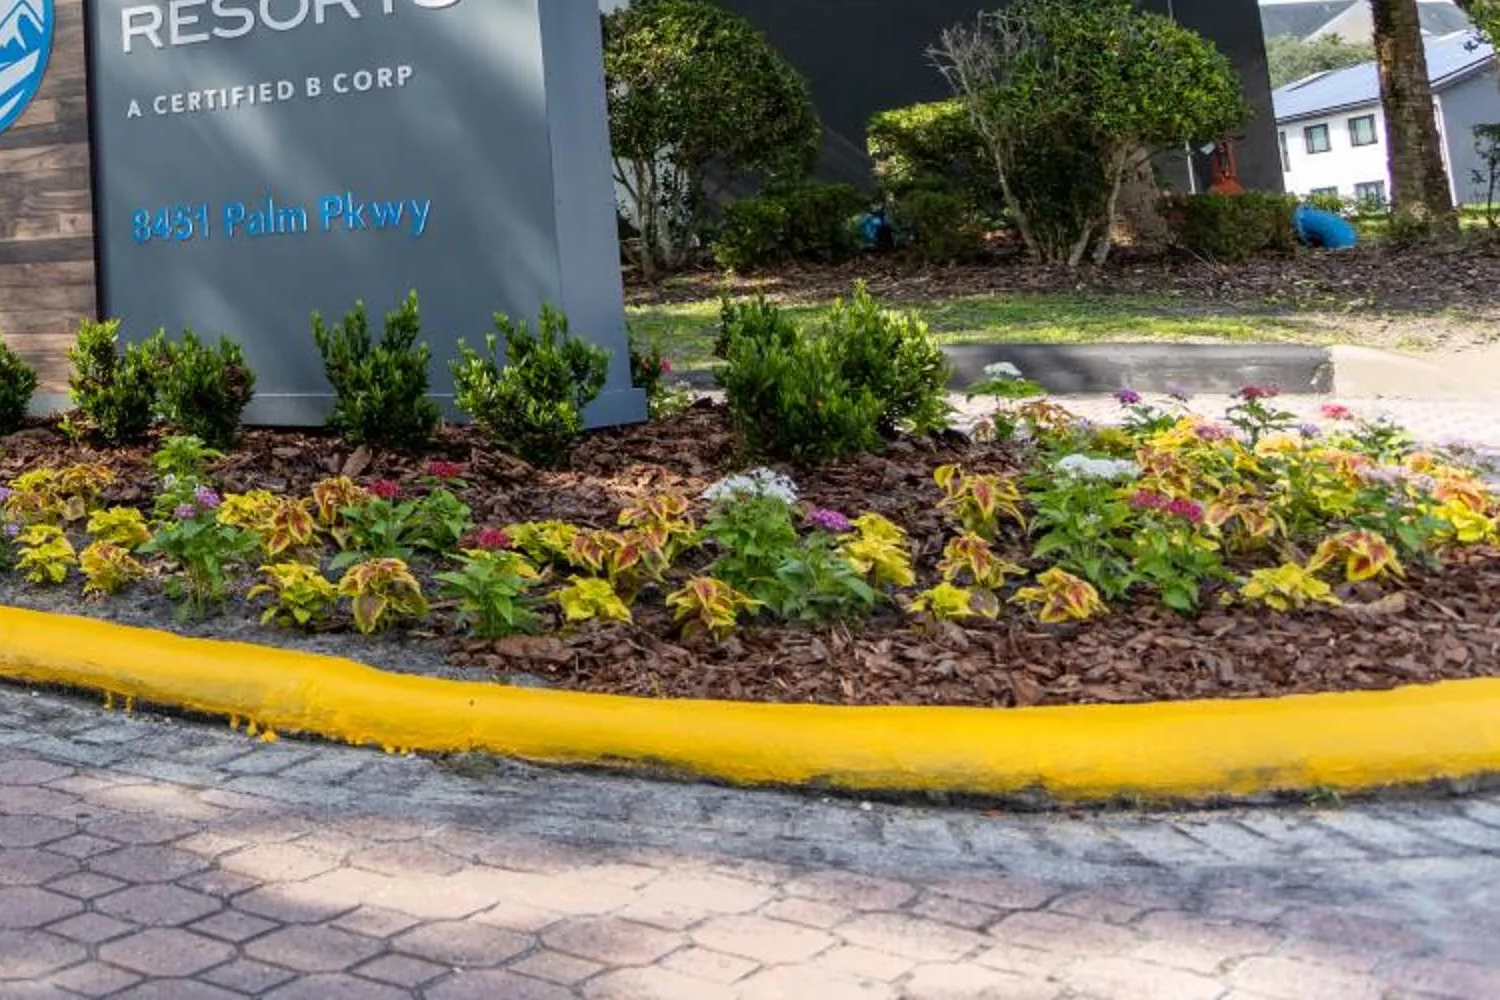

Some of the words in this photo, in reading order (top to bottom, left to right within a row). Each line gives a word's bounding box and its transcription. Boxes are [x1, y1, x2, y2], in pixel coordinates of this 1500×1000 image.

[127, 99, 143, 118] A
[153, 80, 295, 115] CERTIFIED
[306, 76, 322, 98] B
[332, 65, 414, 94] CORP
[131, 204, 210, 245] 8451
[224, 197, 308, 237] Palm
[320, 191, 432, 237] Pkwy
